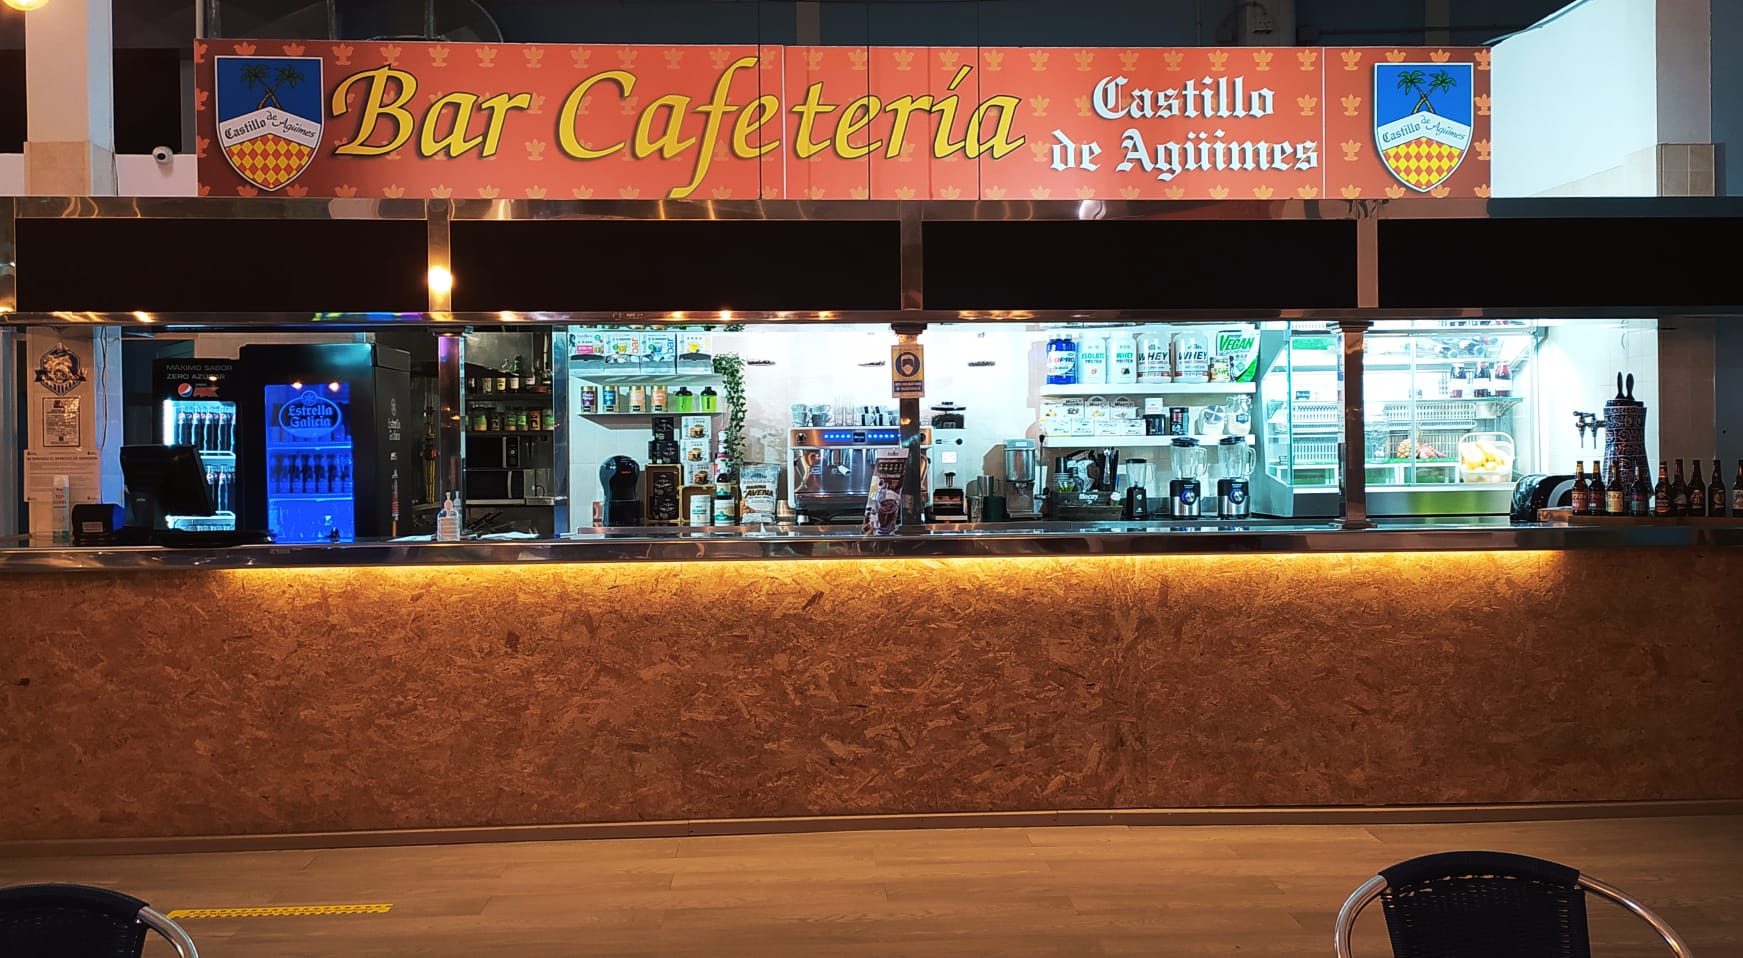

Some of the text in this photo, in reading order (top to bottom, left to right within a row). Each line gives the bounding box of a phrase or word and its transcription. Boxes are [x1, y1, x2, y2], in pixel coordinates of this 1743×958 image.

[1092, 75, 1276, 120] Castillo
[224, 110, 317, 140] Castillo de Agüimes
[331, 55, 1026, 199] Bar Cafetería
[1382, 114, 1466, 144] Castillo de Agüimes
[1050, 128, 1319, 183] de Agüimes
[1219, 334, 1255, 351] VEGAN
[1138, 351, 1169, 361] WHEY
[1178, 351, 1208, 361] WHEY
[288, 404, 333, 417] Estrella
[290, 415, 331, 428] Galicia
[745, 488, 774, 499] AVENA
